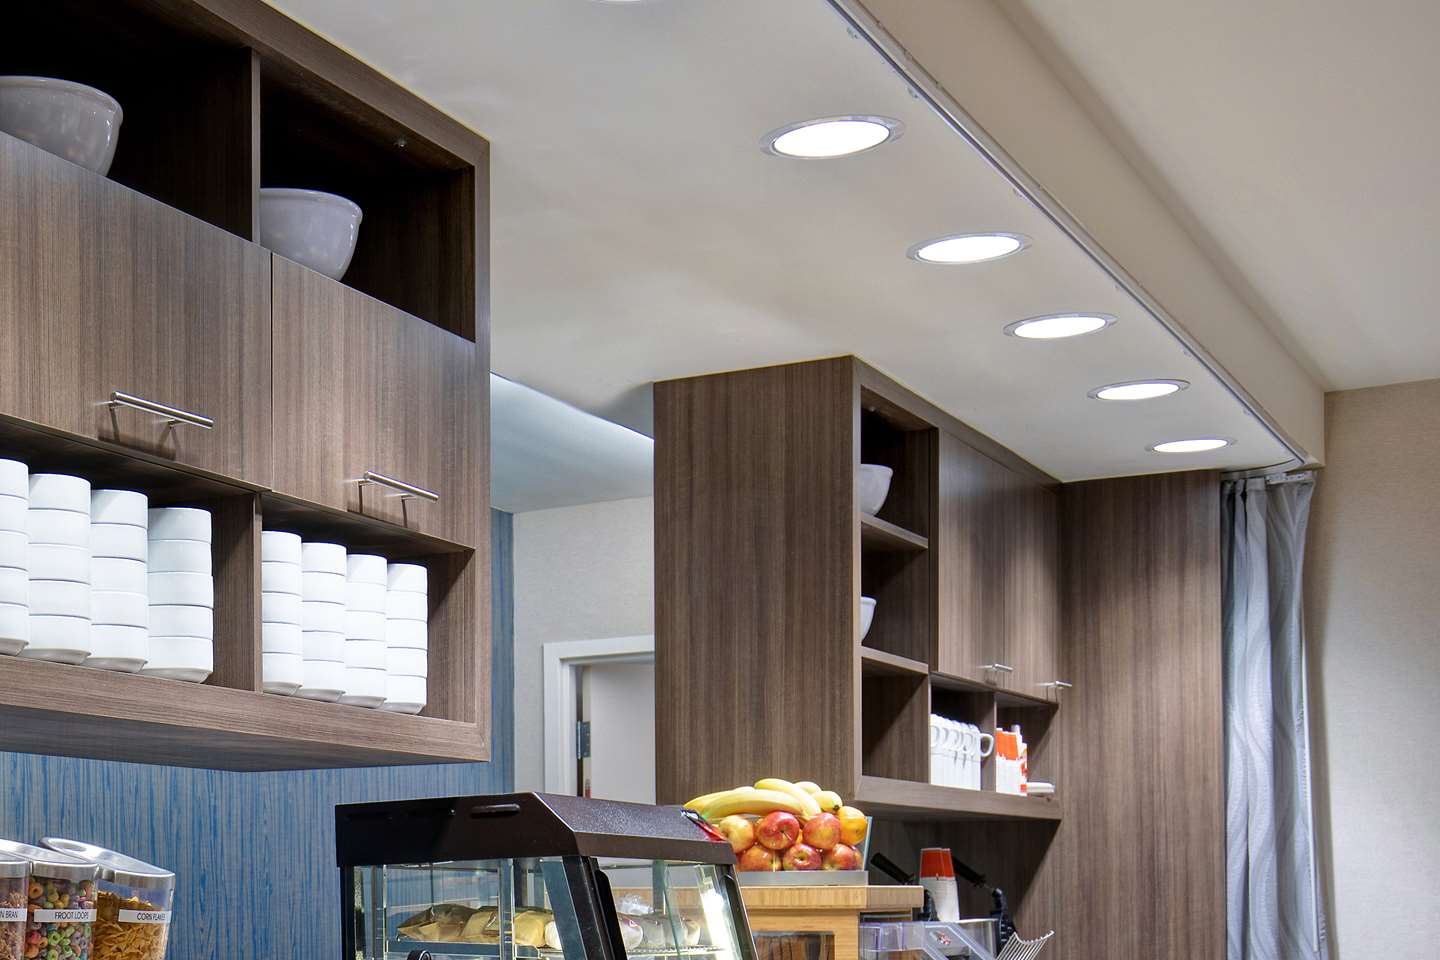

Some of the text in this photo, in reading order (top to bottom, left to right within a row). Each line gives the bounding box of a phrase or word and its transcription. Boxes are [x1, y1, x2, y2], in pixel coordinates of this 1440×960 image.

[5, 910, 19, 919] BRAN
[54, 911, 90, 920] FROOT LOOPS
[136, 912, 153, 921] CORN
